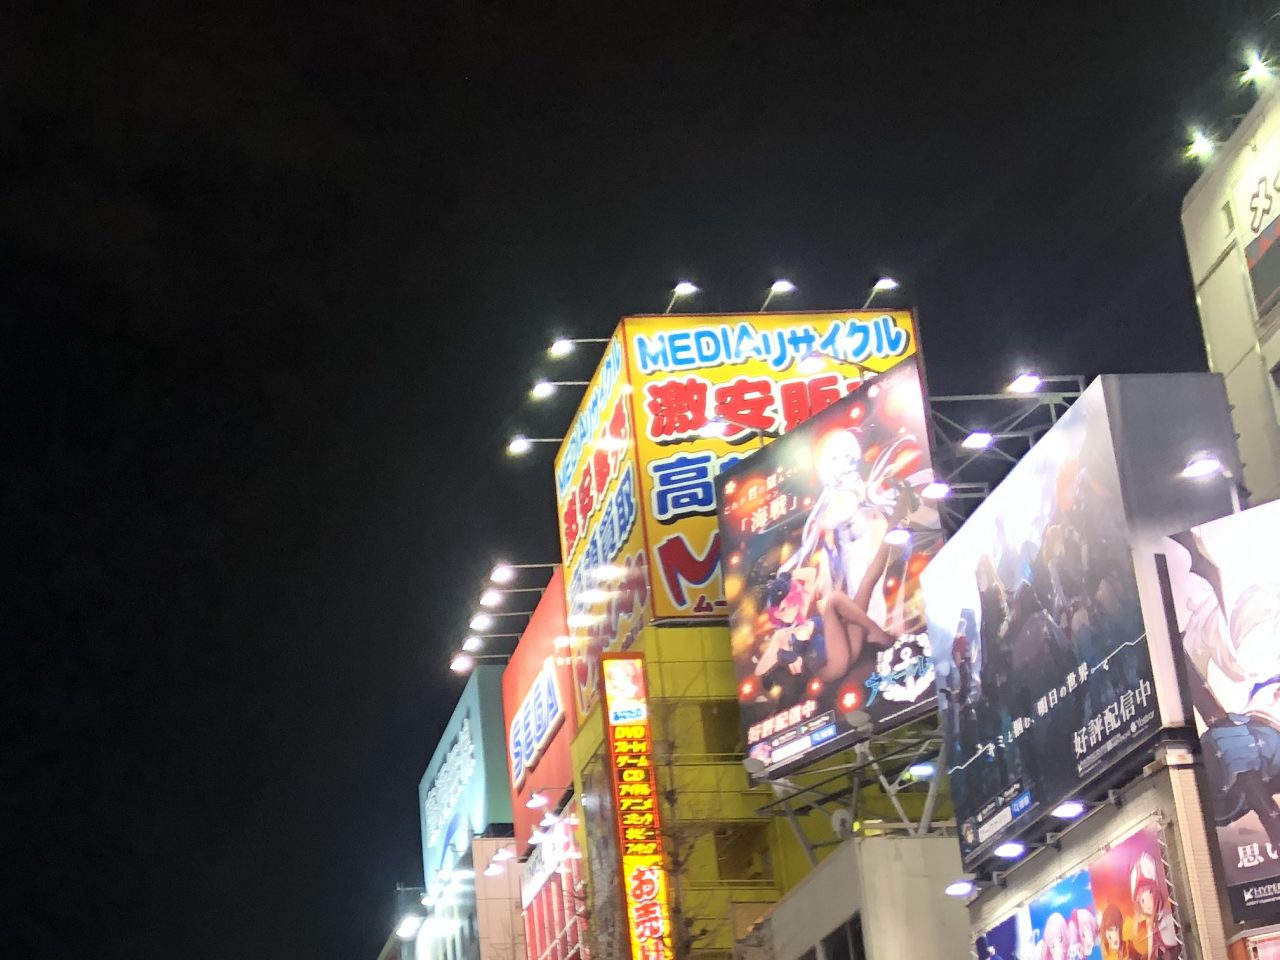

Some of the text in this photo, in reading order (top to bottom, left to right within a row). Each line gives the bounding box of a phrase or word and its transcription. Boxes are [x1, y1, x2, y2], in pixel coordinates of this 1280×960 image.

[634, 315, 908, 374] MEDIAリサイクル
[648, 374, 872, 448] 激安販
[512, 660, 562, 788] SEGA
[1073, 678, 1153, 761] 好評配信中
[622, 768, 645, 781] CD
[1237, 843, 1279, 868] 思い
